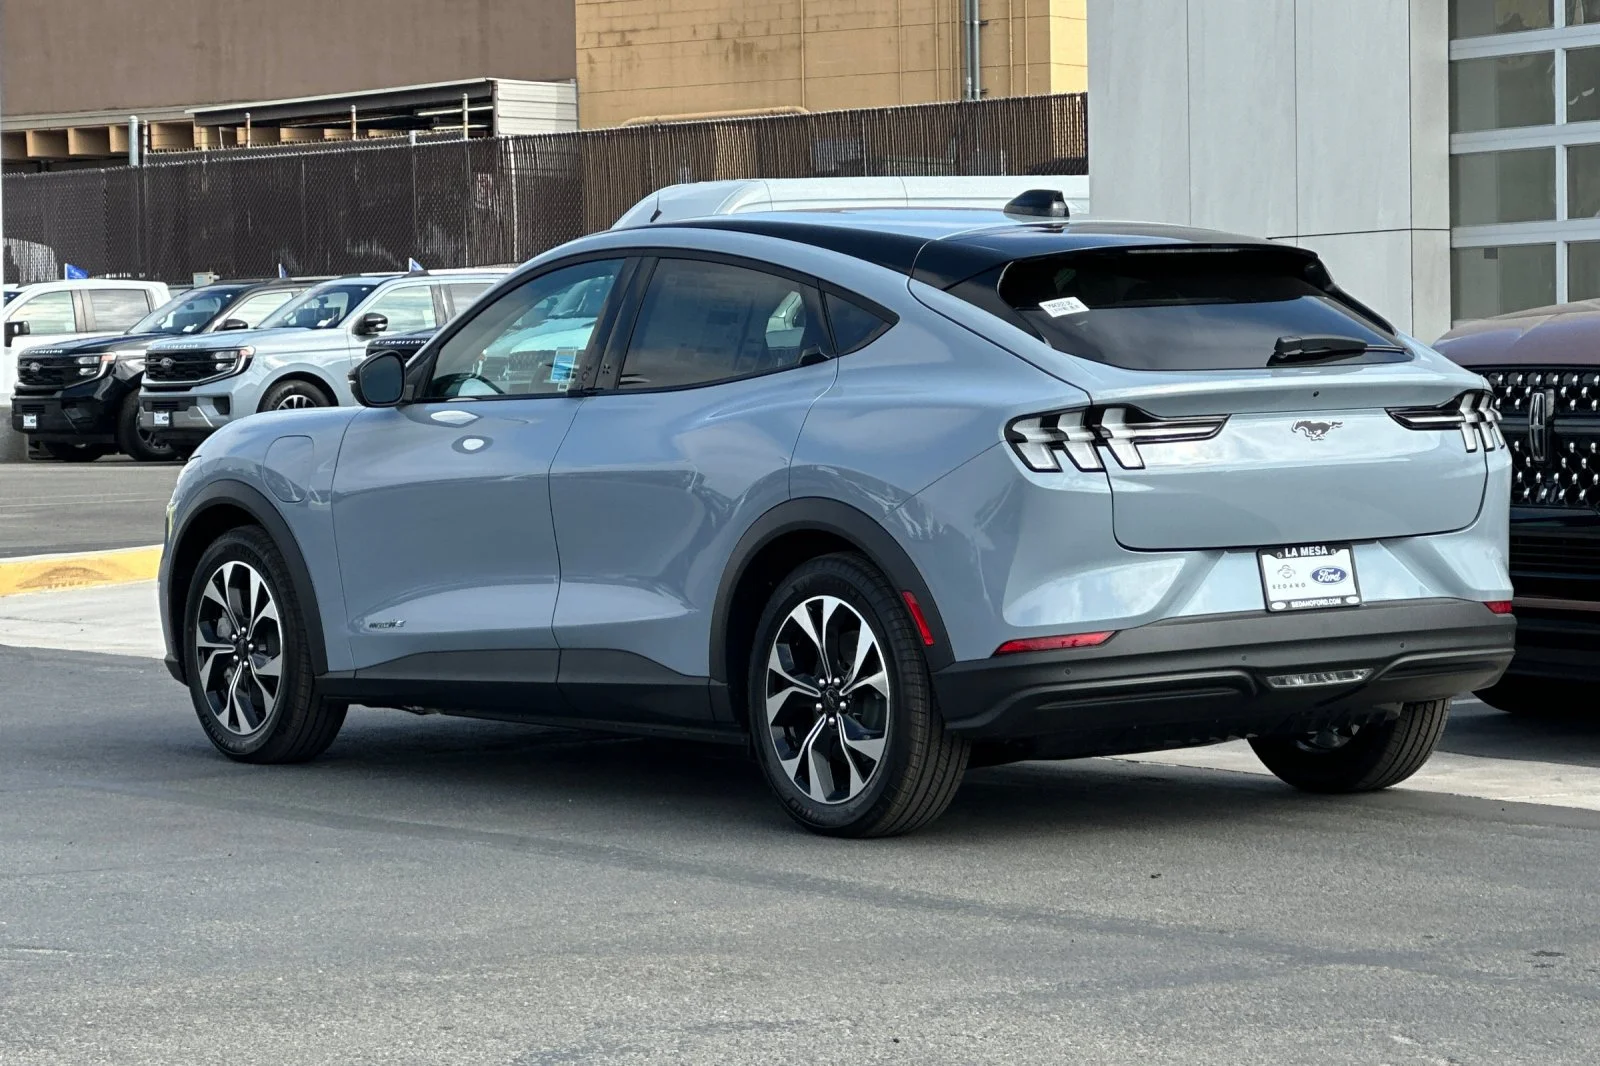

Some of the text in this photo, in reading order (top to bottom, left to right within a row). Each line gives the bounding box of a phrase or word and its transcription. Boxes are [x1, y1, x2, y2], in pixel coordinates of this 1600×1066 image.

[1284, 545, 1329, 558] LA MESA
[1317, 568, 1341, 582] Ford
